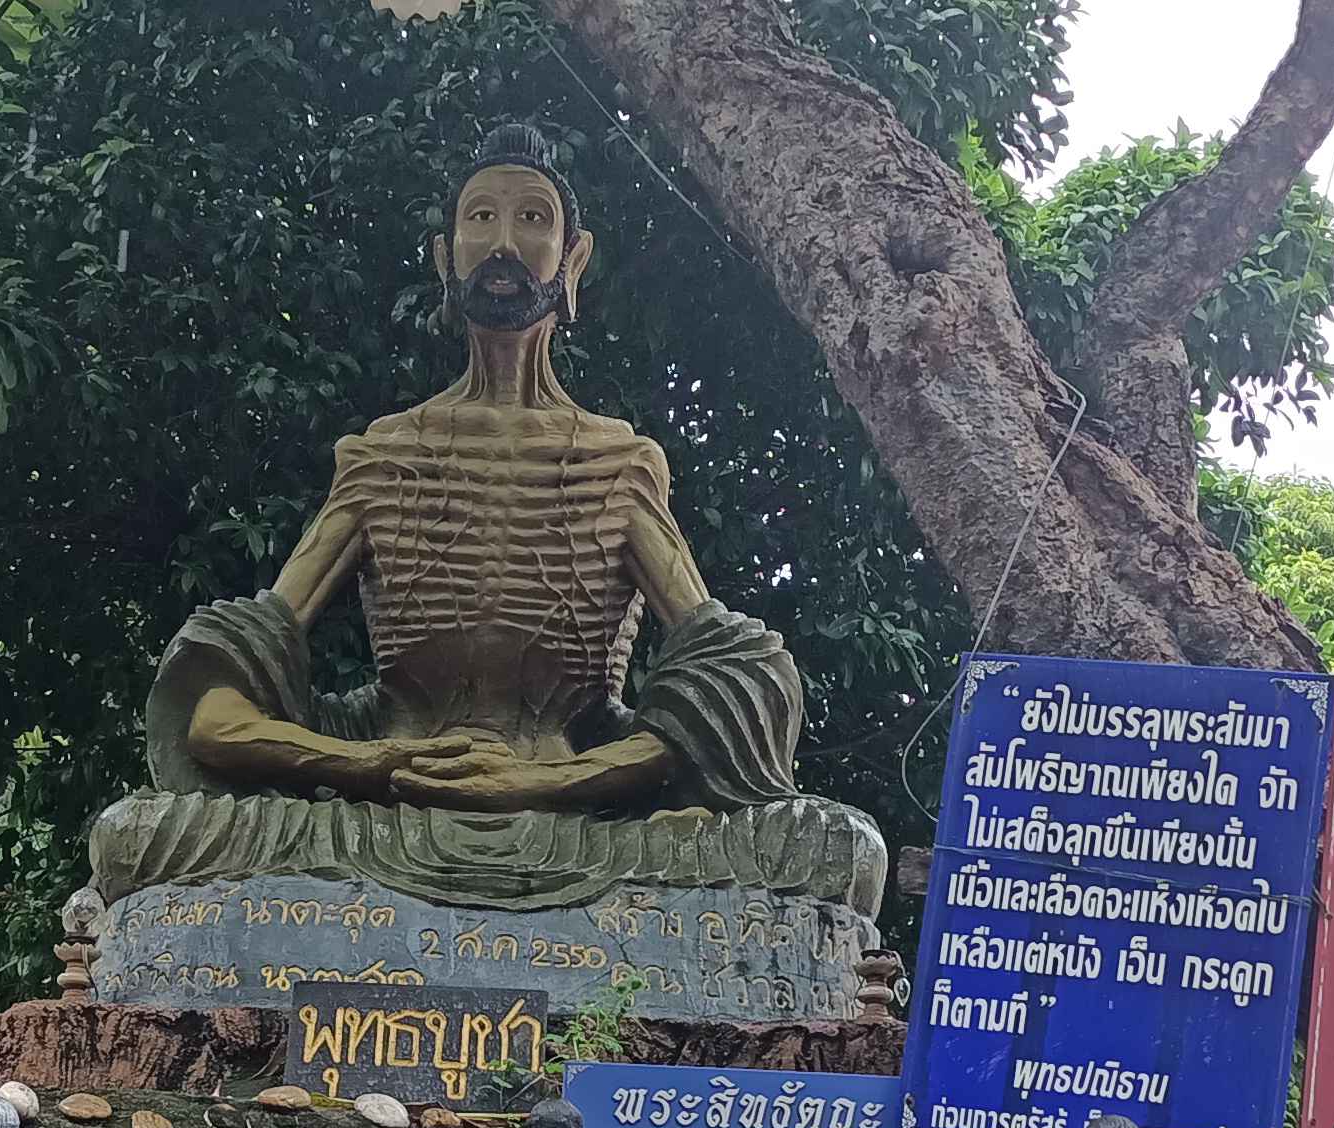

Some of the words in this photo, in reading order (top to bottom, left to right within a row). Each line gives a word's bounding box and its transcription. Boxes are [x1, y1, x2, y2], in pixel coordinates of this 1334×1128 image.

[966, 738, 1238, 806] สัมโพธิญาณเพียงใด
[1258, 766, 1297, 811] จัก
[964, 794, 1256, 870] ไม่เสด็จลุกขึ้นเพียงนั้น
[419, 928, 443, 960] 2
[529, 937, 608, 968] 2550
[939, 926, 1100, 980] เหลือแต่หนัง
[1116, 935, 1166, 987] เอ็น
[1181, 956, 1273, 1007] กระดูก
[299, 998, 543, 1100] พุทธบูชา
[1013, 1059, 1168, 1104] พุทธปณิธาน
